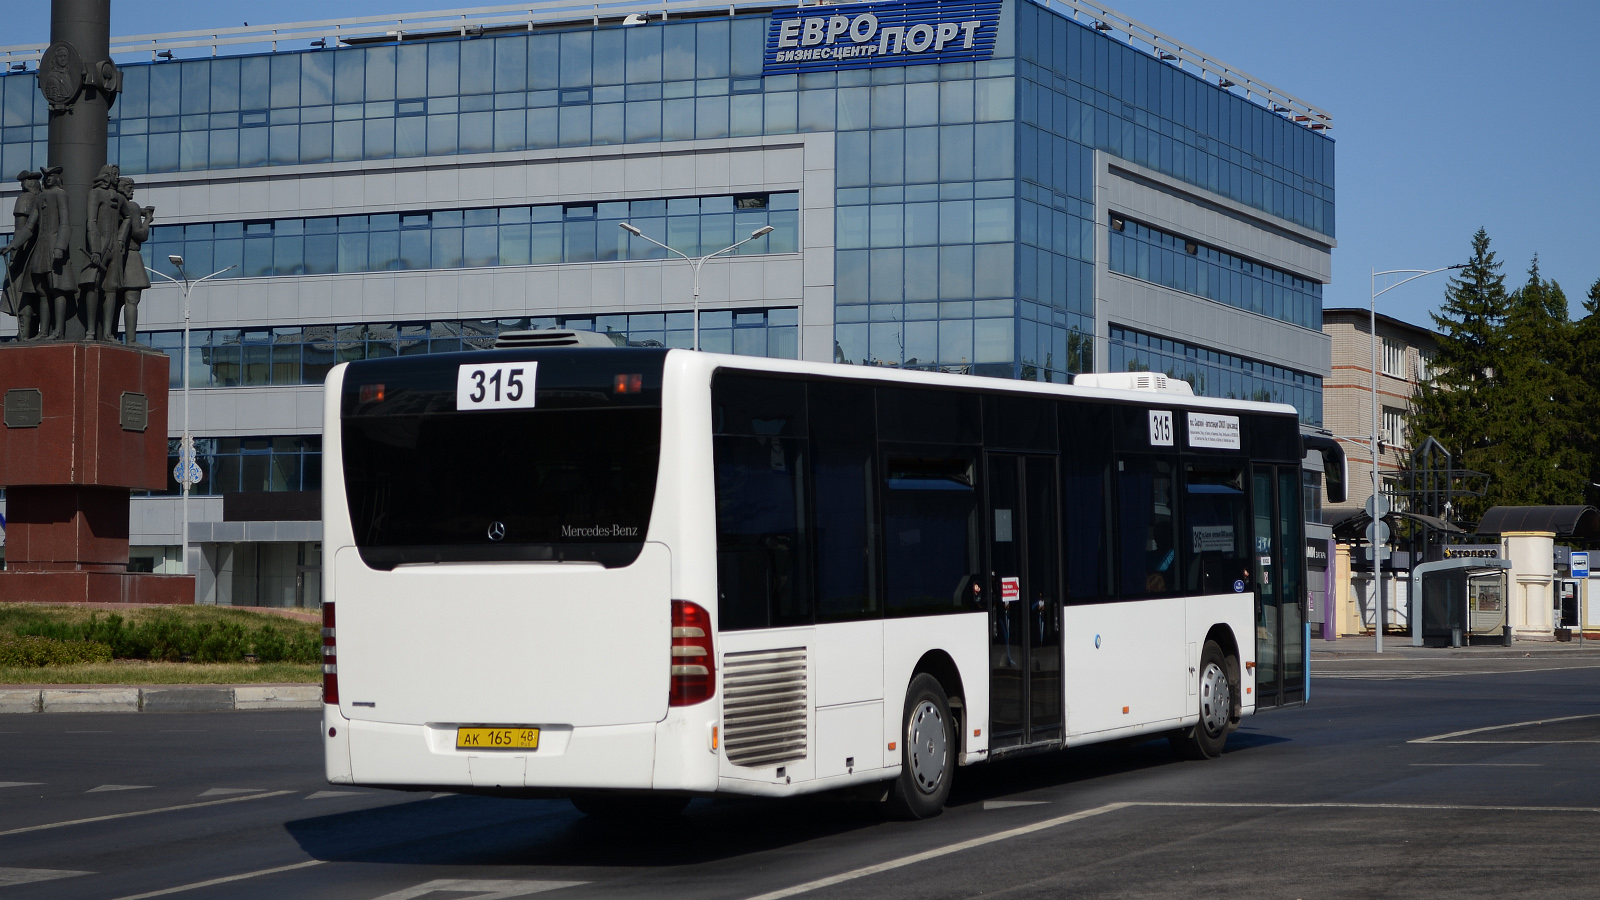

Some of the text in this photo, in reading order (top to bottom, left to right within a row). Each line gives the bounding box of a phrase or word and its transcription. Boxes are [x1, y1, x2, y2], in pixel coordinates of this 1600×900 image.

[470, 369, 524, 403] 315
[1154, 416, 1170, 440] 315
[561, 524, 638, 538] Mercedes-Benz
[1193, 531, 1202, 548] 315
[488, 730, 512, 745] 165
[520, 730, 534, 742] 48
